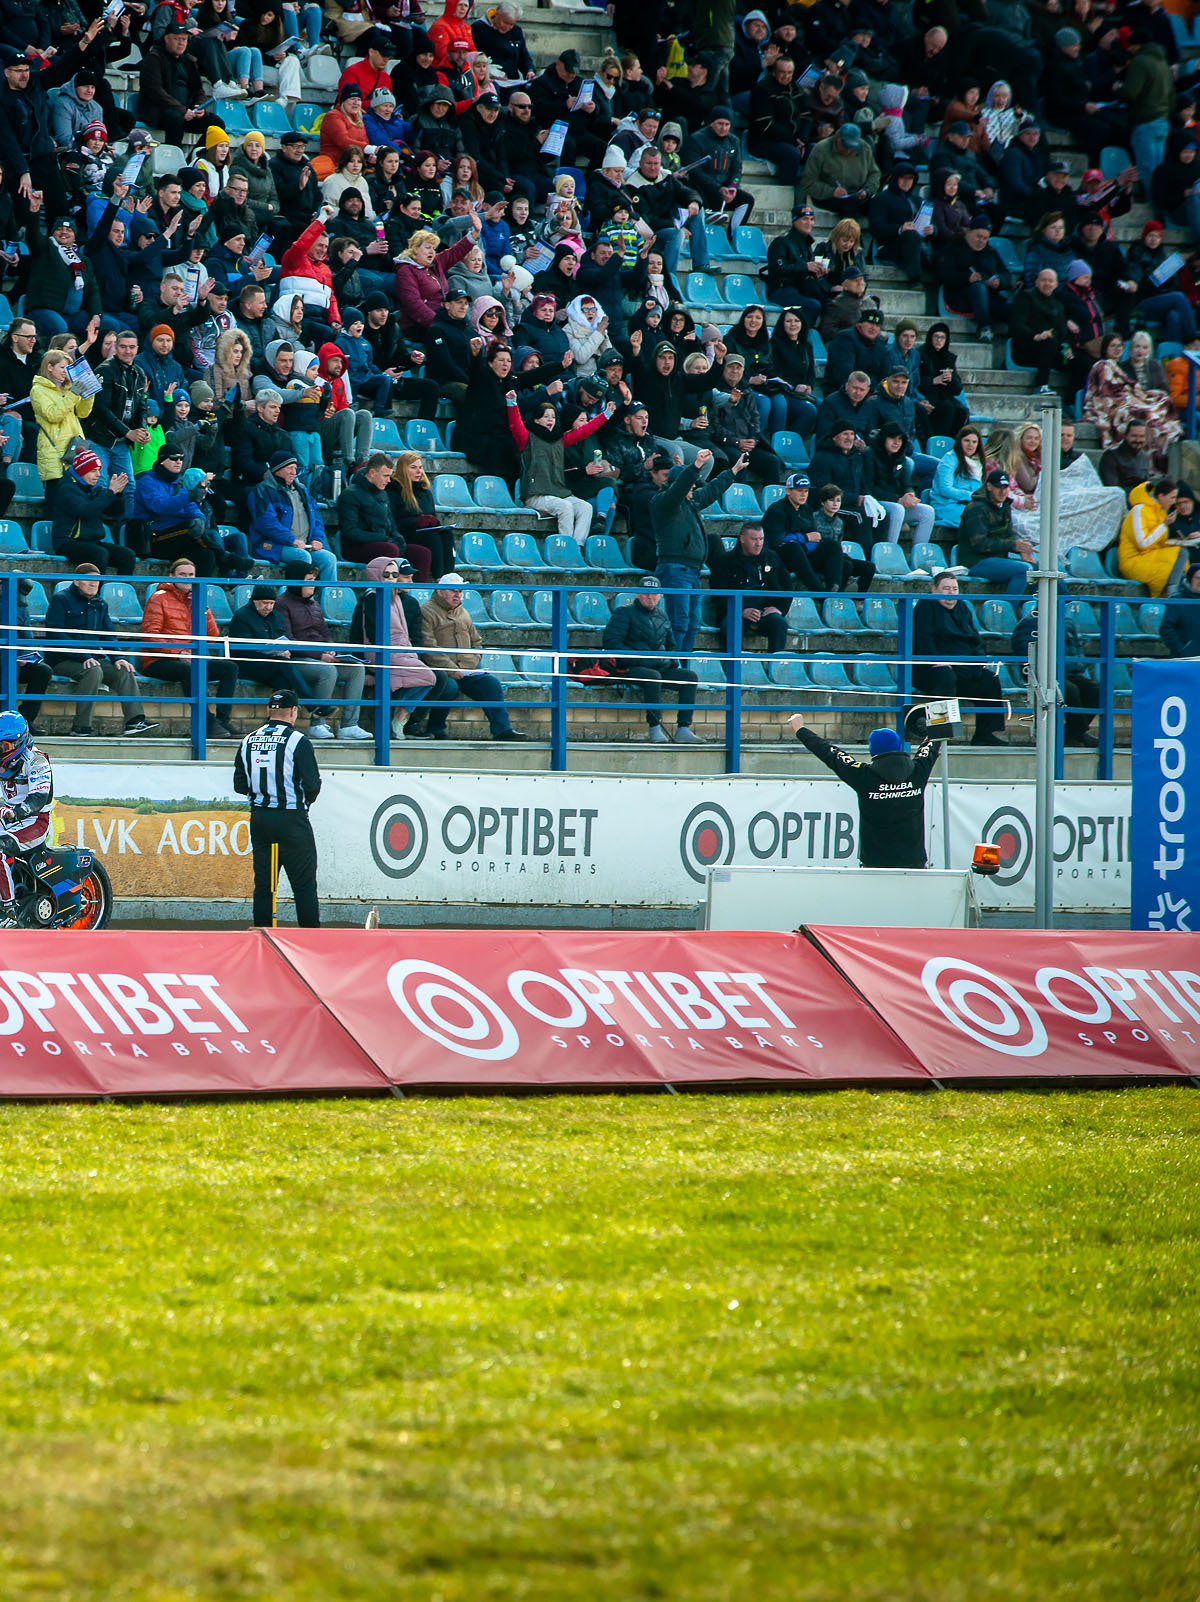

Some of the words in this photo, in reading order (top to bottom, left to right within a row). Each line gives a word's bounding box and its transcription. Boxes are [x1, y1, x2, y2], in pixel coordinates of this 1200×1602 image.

[0, 524, 8, 532] 17
[868, 788, 922, 800] TECHNICZNA
[1152, 696, 1186, 880] trodo
[156, 819, 253, 856] AGRO
[442, 805, 599, 857] OPTIBET
[748, 810, 860, 860] OPTIB
[1052, 815, 1132, 862] OPTI
[440, 861, 527, 875] SPORTA
[543, 861, 596, 875] BĀRS
[1057, 868, 1122, 879] PORTA
[507, 968, 797, 1030] OPTIBET
[171, 1037, 276, 1057] BĀRS
[551, 1033, 705, 1050] SPORTA
[724, 1031, 824, 1050] BĀRS
